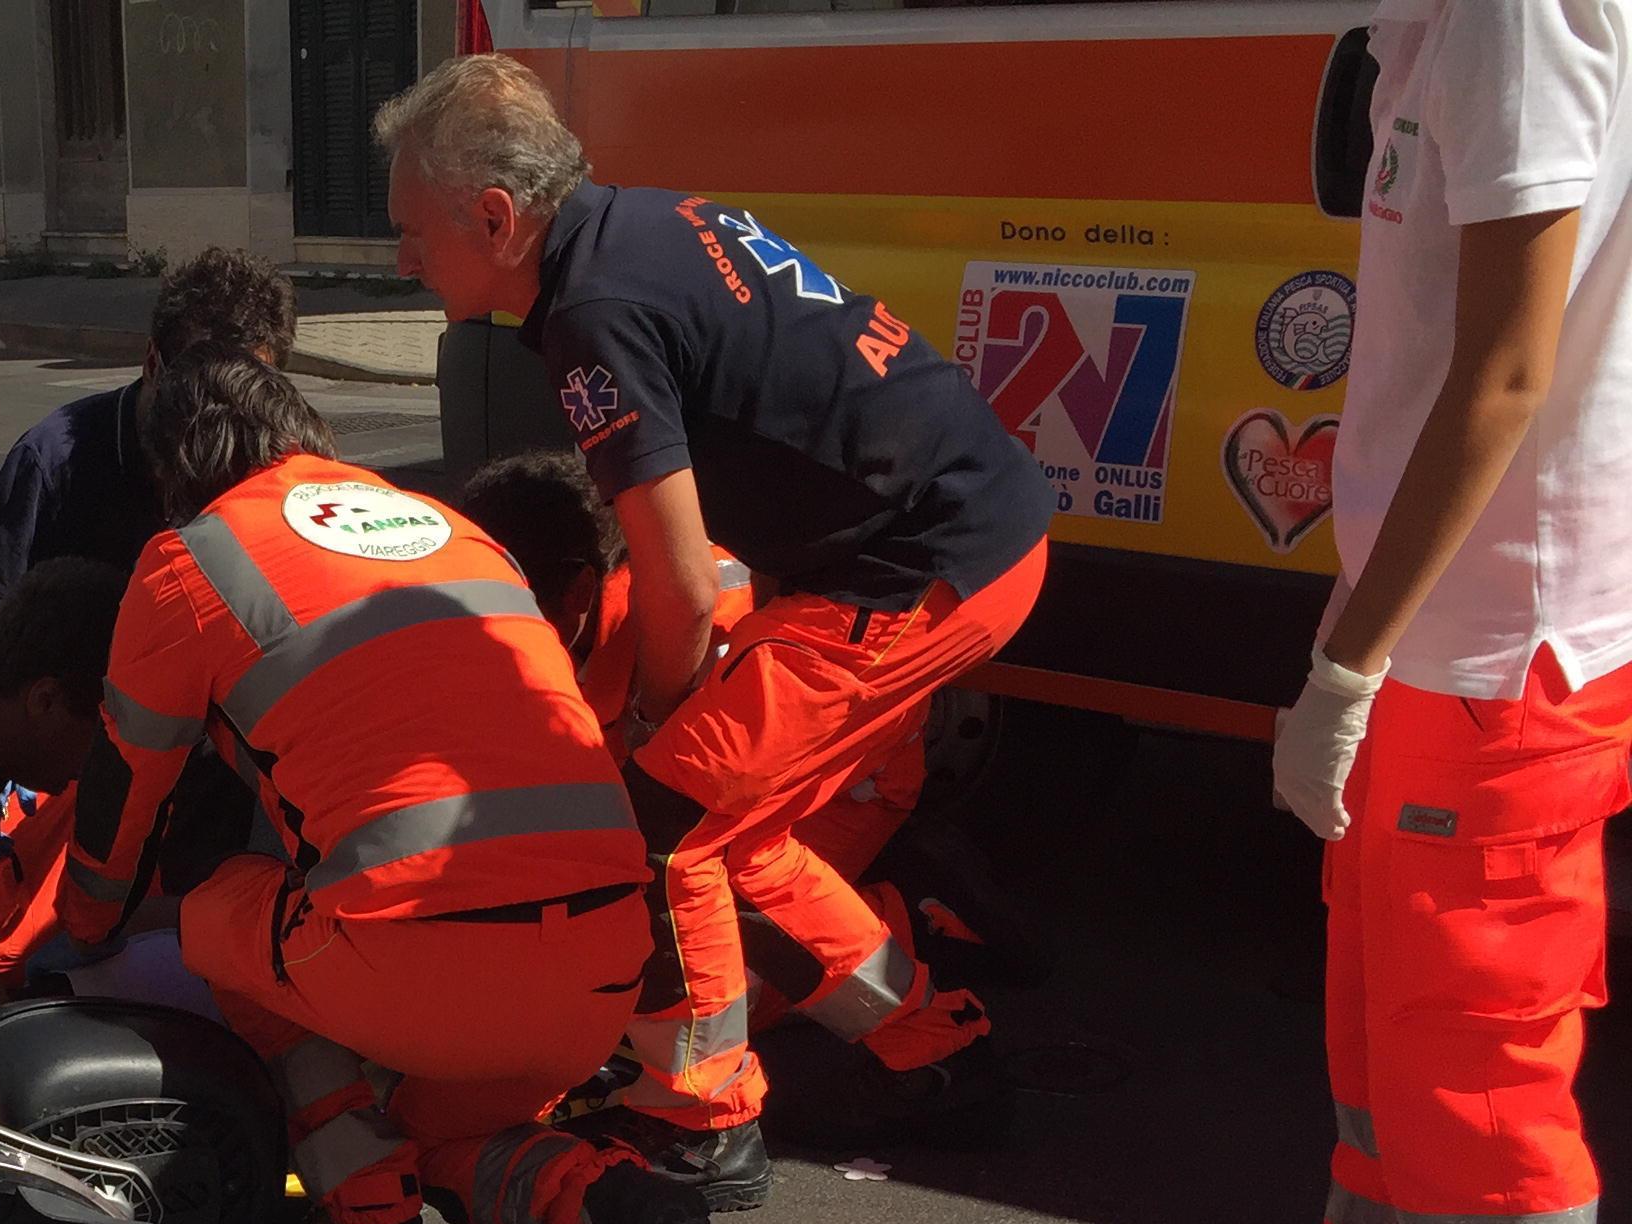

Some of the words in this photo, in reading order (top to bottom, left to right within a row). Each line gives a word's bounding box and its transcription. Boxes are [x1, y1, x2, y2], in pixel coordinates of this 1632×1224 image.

[1000, 220, 1066, 241] Dono
[698, 230, 752, 305] CROCE
[994, 268, 1190, 294] www.niccoclub.com
[1247, 449, 1320, 479] Pesca
[1095, 466, 1163, 490] ONLUS
[1256, 472, 1331, 502] Cuore
[1094, 490, 1162, 523] Galli
[361, 515, 439, 534] ANPAS
[358, 536, 437, 558] VIAREGGIO
